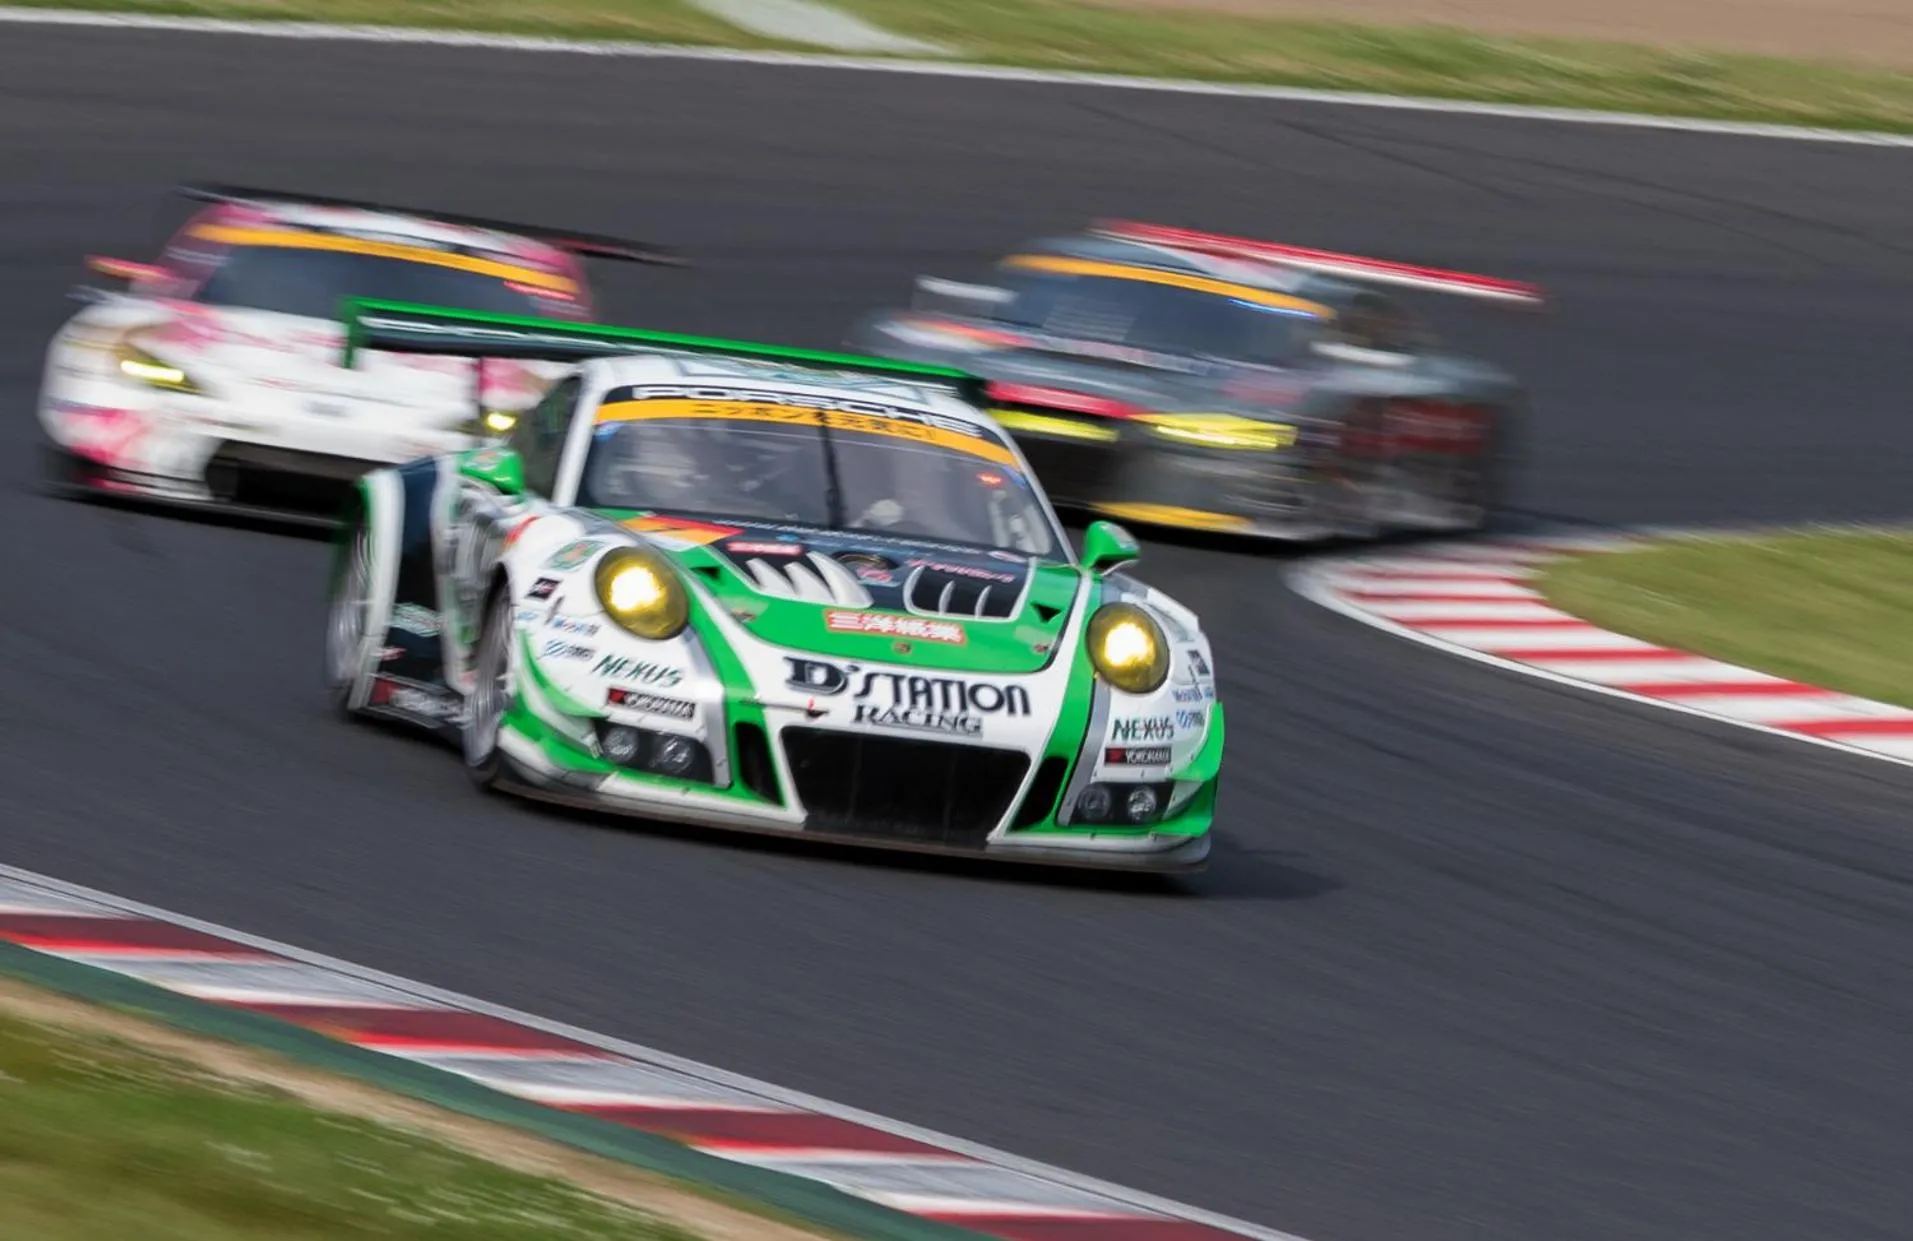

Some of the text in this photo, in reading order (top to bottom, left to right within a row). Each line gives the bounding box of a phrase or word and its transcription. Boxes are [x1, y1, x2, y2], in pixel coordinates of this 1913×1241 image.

[633, 384, 982, 437] PORSCHE
[592, 654, 683, 687] NEXUS
[850, 705, 983, 736] RACING
[1112, 717, 1174, 740] NEXUS
